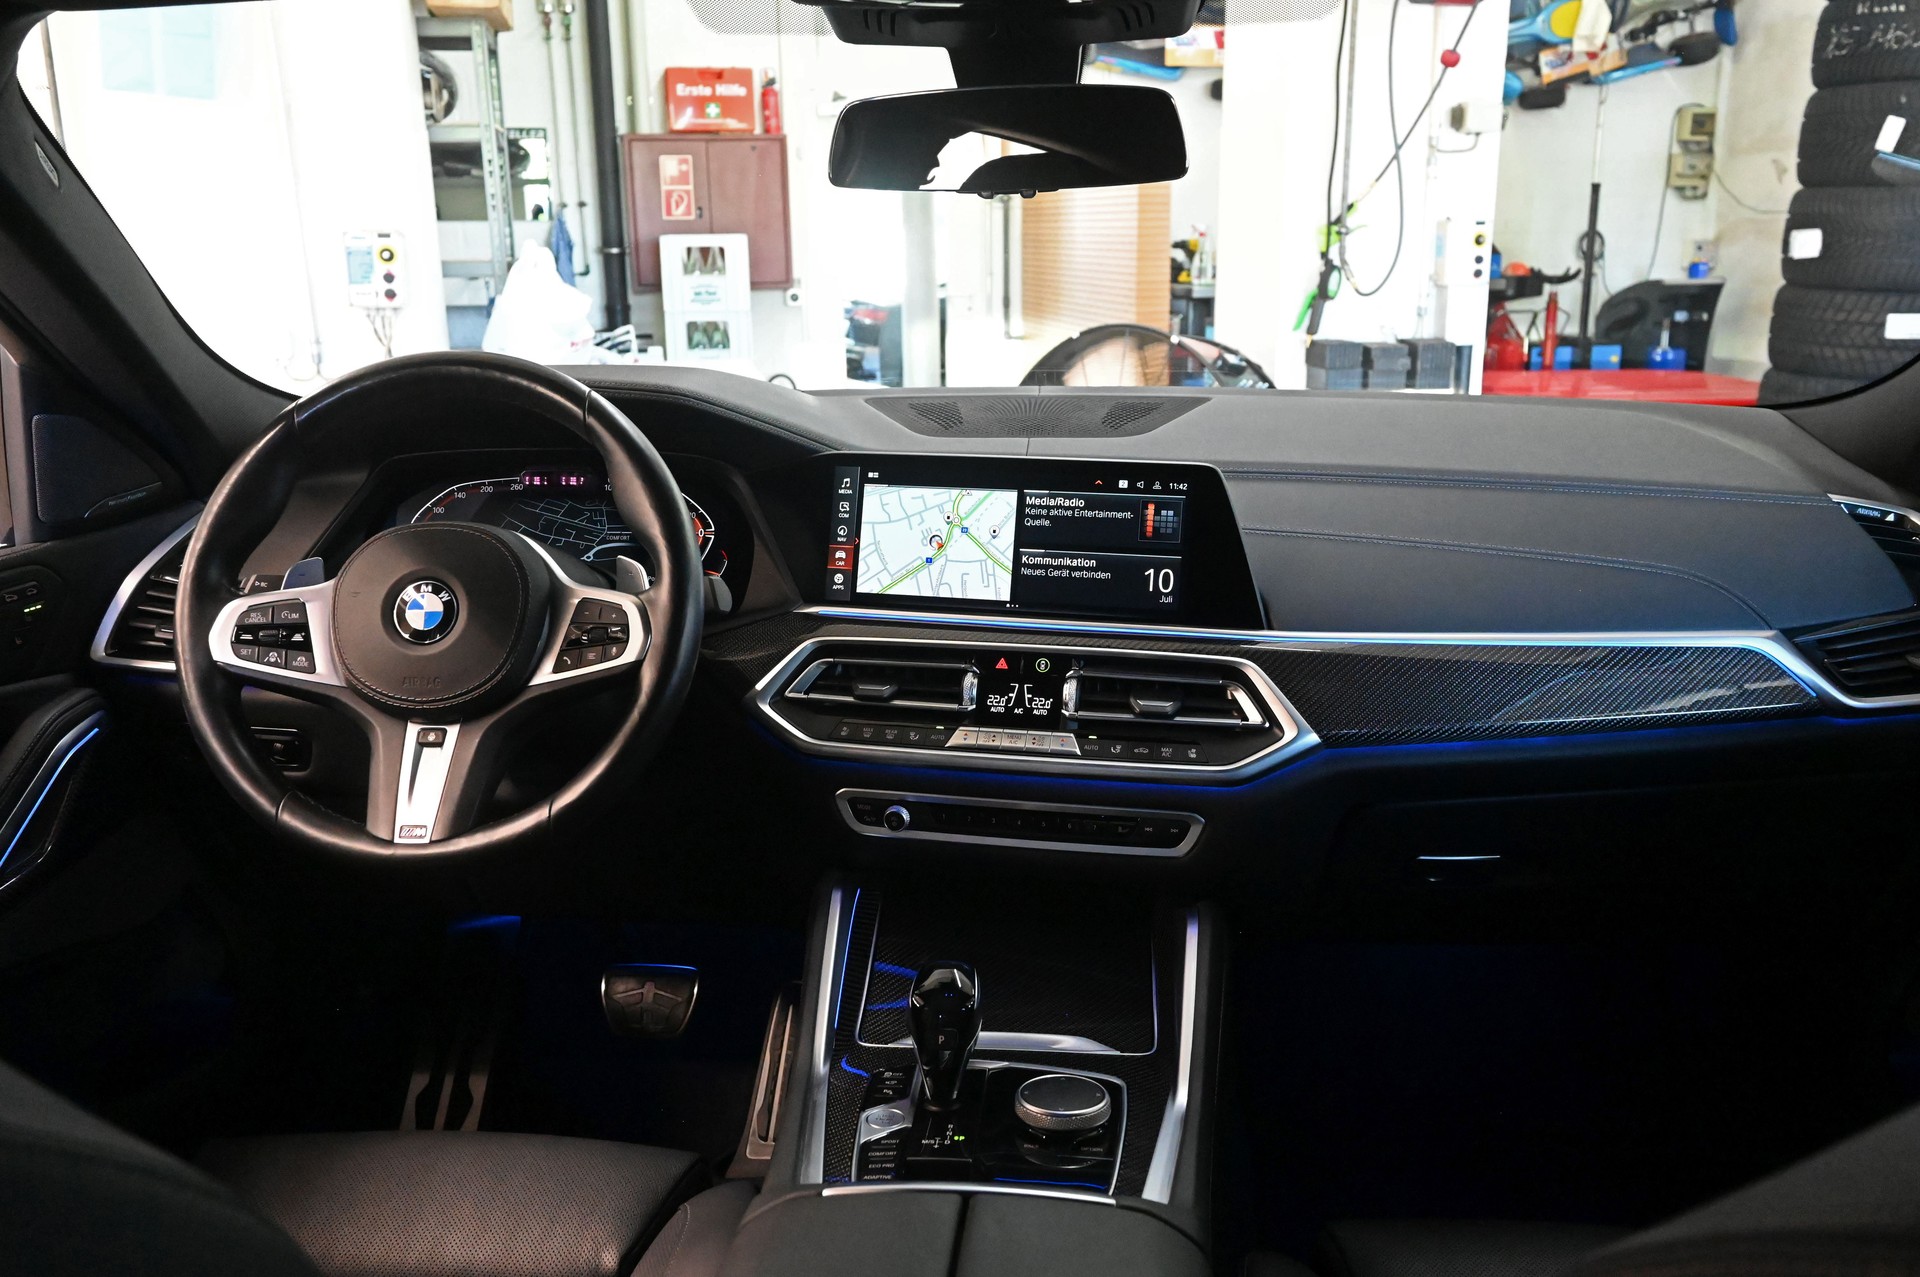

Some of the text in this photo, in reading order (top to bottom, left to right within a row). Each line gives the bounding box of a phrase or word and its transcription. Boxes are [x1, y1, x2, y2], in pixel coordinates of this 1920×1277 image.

[675, 83, 747, 96] Erste Hilfe
[1169, 482, 1188, 490] 11:42
[1025, 496, 1085, 508] Media/Radio
[1025, 507, 1134, 519] Keine aktive Entertainment-
[1024, 518, 1052, 527] Quelle.
[698, 529, 704, 537] 0
[1021, 555, 1097, 568] Kommunikation
[1021, 567, 1111, 580] Neues Gerät verbinden
[1144, 568, 1174, 594] 10
[402, 584, 452, 603] BMW
[1159, 595, 1173, 603] Juli
[938, 1035, 945, 1045] P
